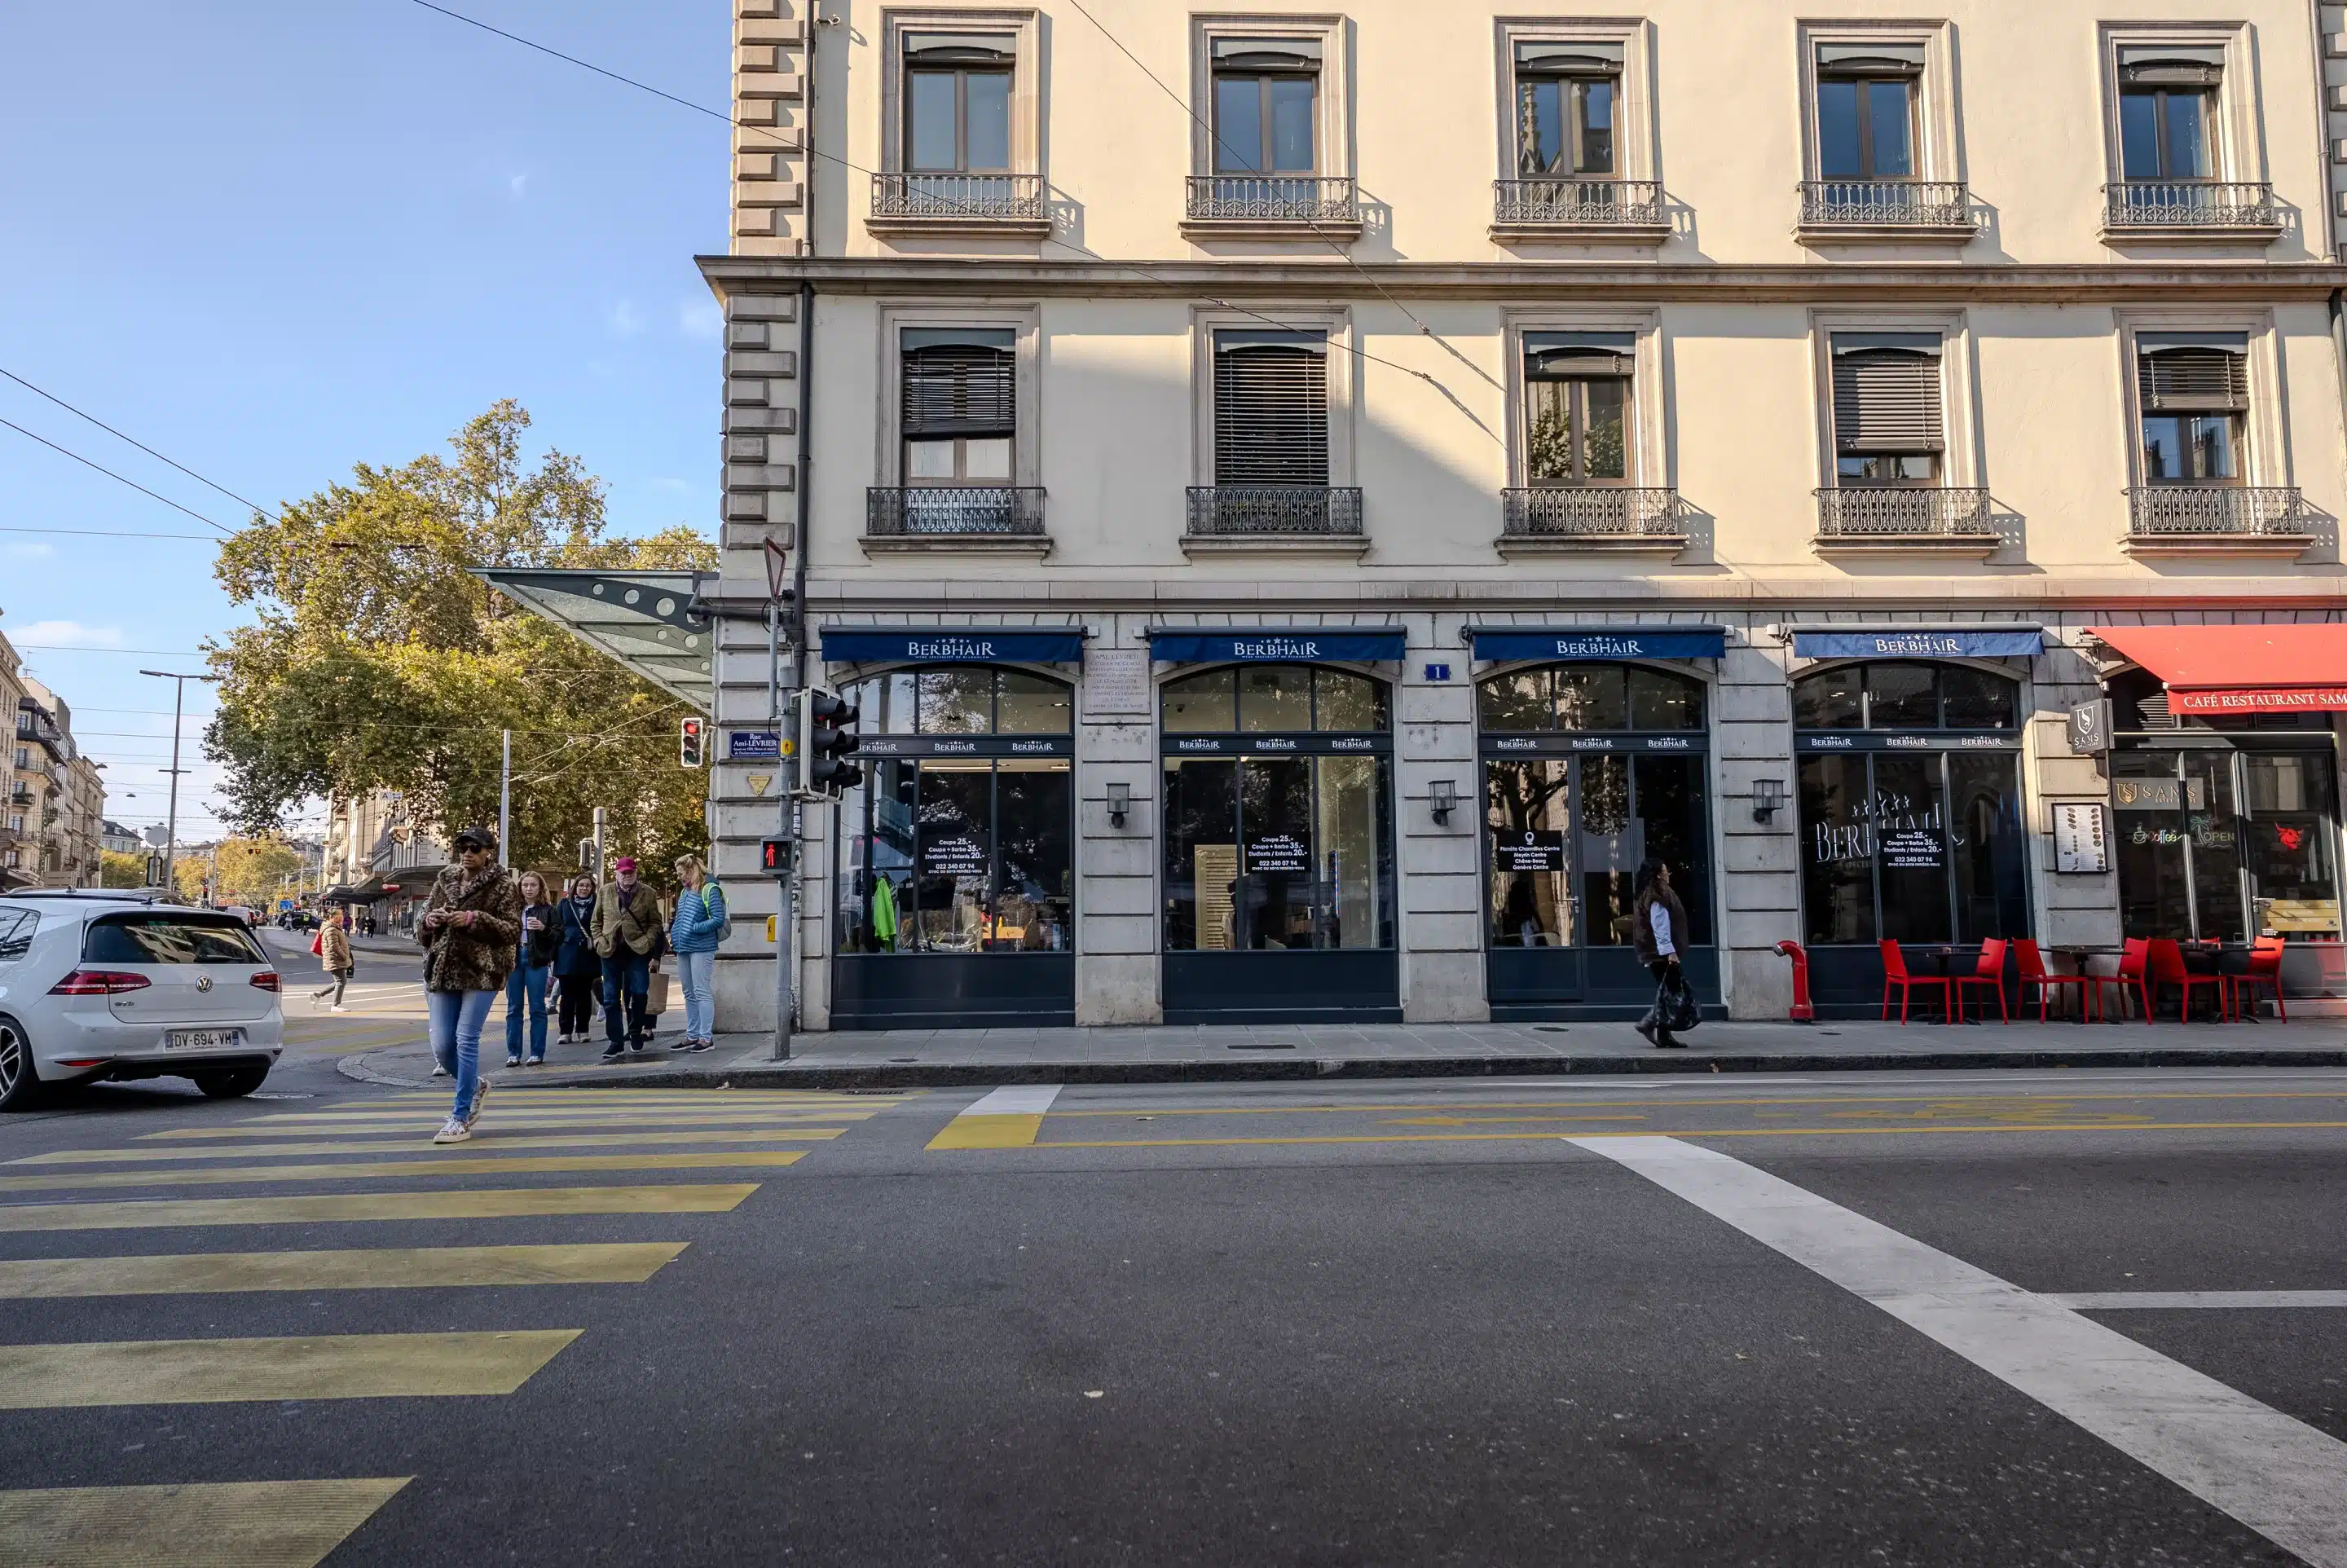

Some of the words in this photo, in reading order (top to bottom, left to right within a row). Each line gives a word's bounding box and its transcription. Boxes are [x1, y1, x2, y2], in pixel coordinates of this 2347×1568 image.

[908, 641, 997, 655] BERBHAIR
[1234, 641, 1321, 655] BERBHAIR
[1557, 640, 1644, 653] BERBHAIR
[1875, 638, 1962, 651] BERBHAIR
[1434, 666, 1441, 679] 1
[2183, 694, 2219, 707] CAFÉ
[2222, 694, 2315, 707] RESTAURANT
[2318, 694, 2347, 704] SAM
[1572, 739, 1614, 748] BERBHAIR
[1648, 739, 1689, 747] BERBHAIR
[1812, 738, 1852, 747] BERBHAIR
[1887, 738, 1928, 747] BERBHAIR
[1962, 738, 2002, 747] BERBHAIR
[2074, 732, 2099, 746] SAMS
[935, 742, 976, 751] BERBHAIR
[1012, 742, 1054, 751] BERBHAIR
[1179, 741, 1220, 749] BERBHAIR
[1256, 741, 1297, 749] BERBHAIR
[1332, 740, 1372, 748] BERBHAIR
[1497, 740, 1538, 748] BERBHAIR
[2147, 830, 2177, 844] Coffee
[2203, 832, 2235, 842] OPEN
